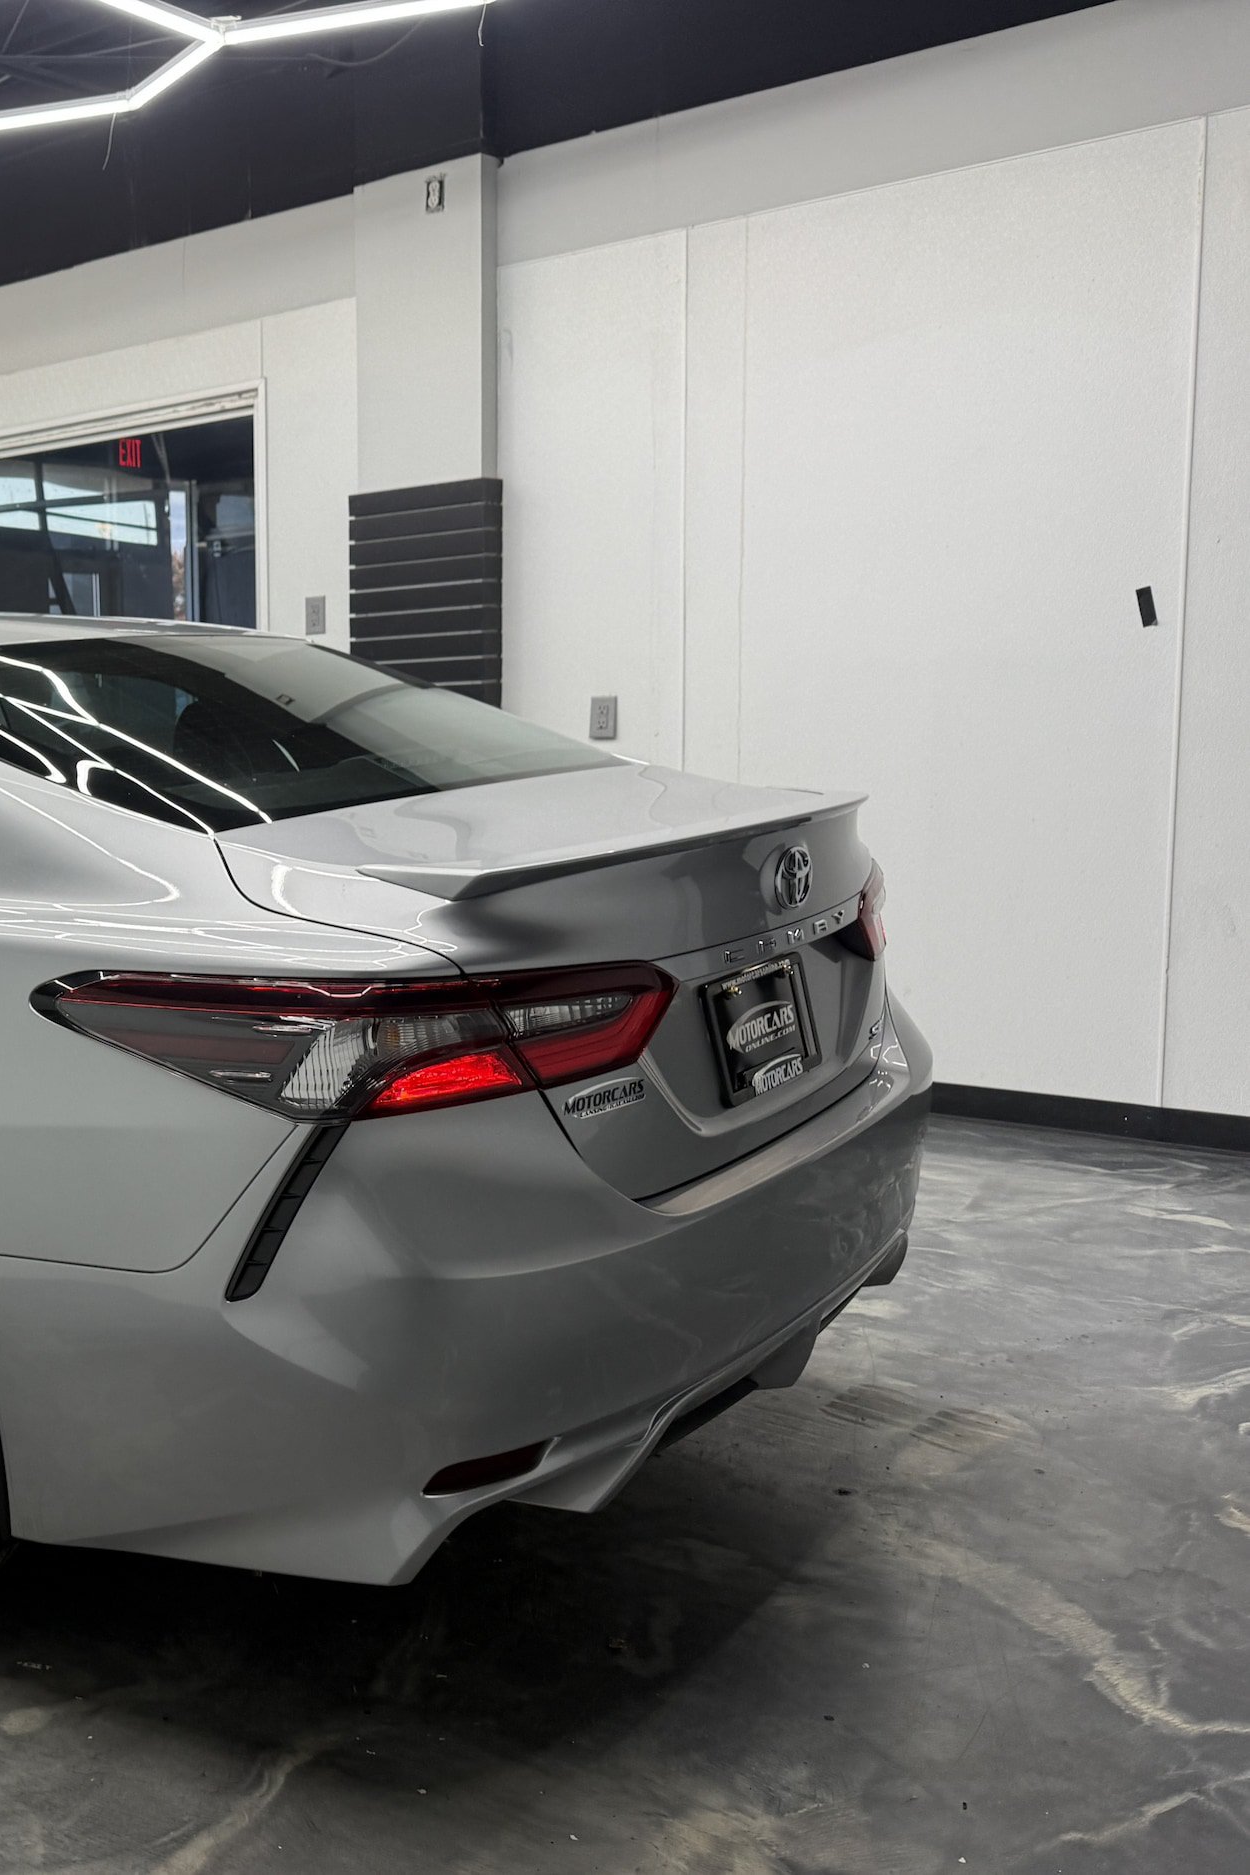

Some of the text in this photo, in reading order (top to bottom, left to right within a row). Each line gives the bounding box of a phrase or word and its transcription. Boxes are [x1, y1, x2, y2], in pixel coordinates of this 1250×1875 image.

[119, 438, 142, 469] EXIT
[728, 1004, 795, 1051] MOTORCARS
[745, 1024, 797, 1053] ONLINE.COM
[754, 1056, 804, 1097] MOTORCARS
[563, 1079, 645, 1116] MOTORCARS
